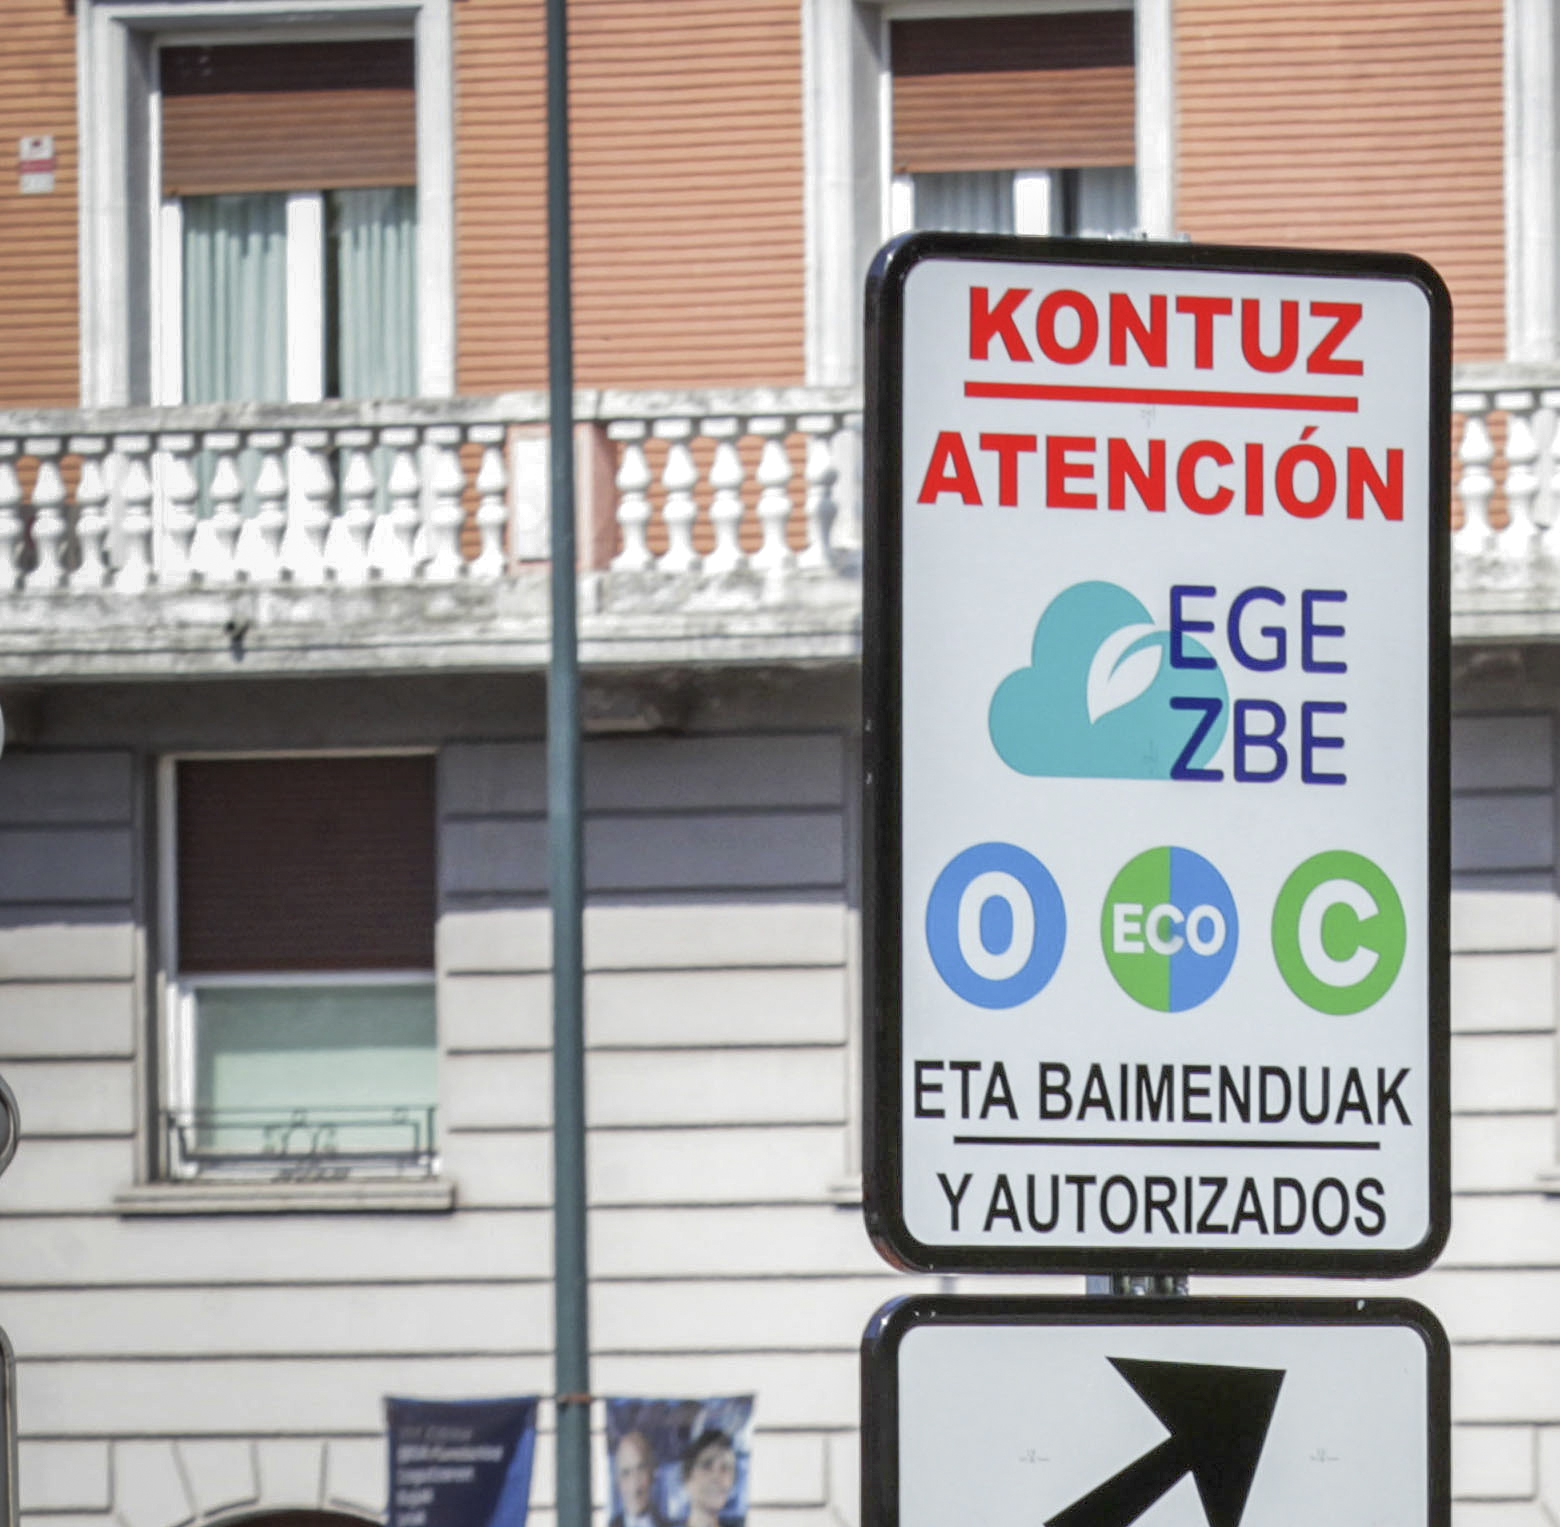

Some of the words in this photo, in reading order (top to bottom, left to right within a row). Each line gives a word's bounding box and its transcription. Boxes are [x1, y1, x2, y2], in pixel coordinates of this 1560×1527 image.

[969, 286, 1364, 376] KONTUZ
[917, 426, 1404, 521] ATENCIÓN
[1170, 585, 1348, 674] EGE
[1170, 697, 1348, 786] ZBE
[1112, 903, 1226, 957] ECO
[1297, 878, 1381, 988] C
[914, 1060, 1019, 1121] ETA
[1039, 1062, 1412, 1126] BAIMENDUAK
[936, 1172, 972, 1232] Y
[984, 1172, 1387, 1236] AUTORIZADOS
